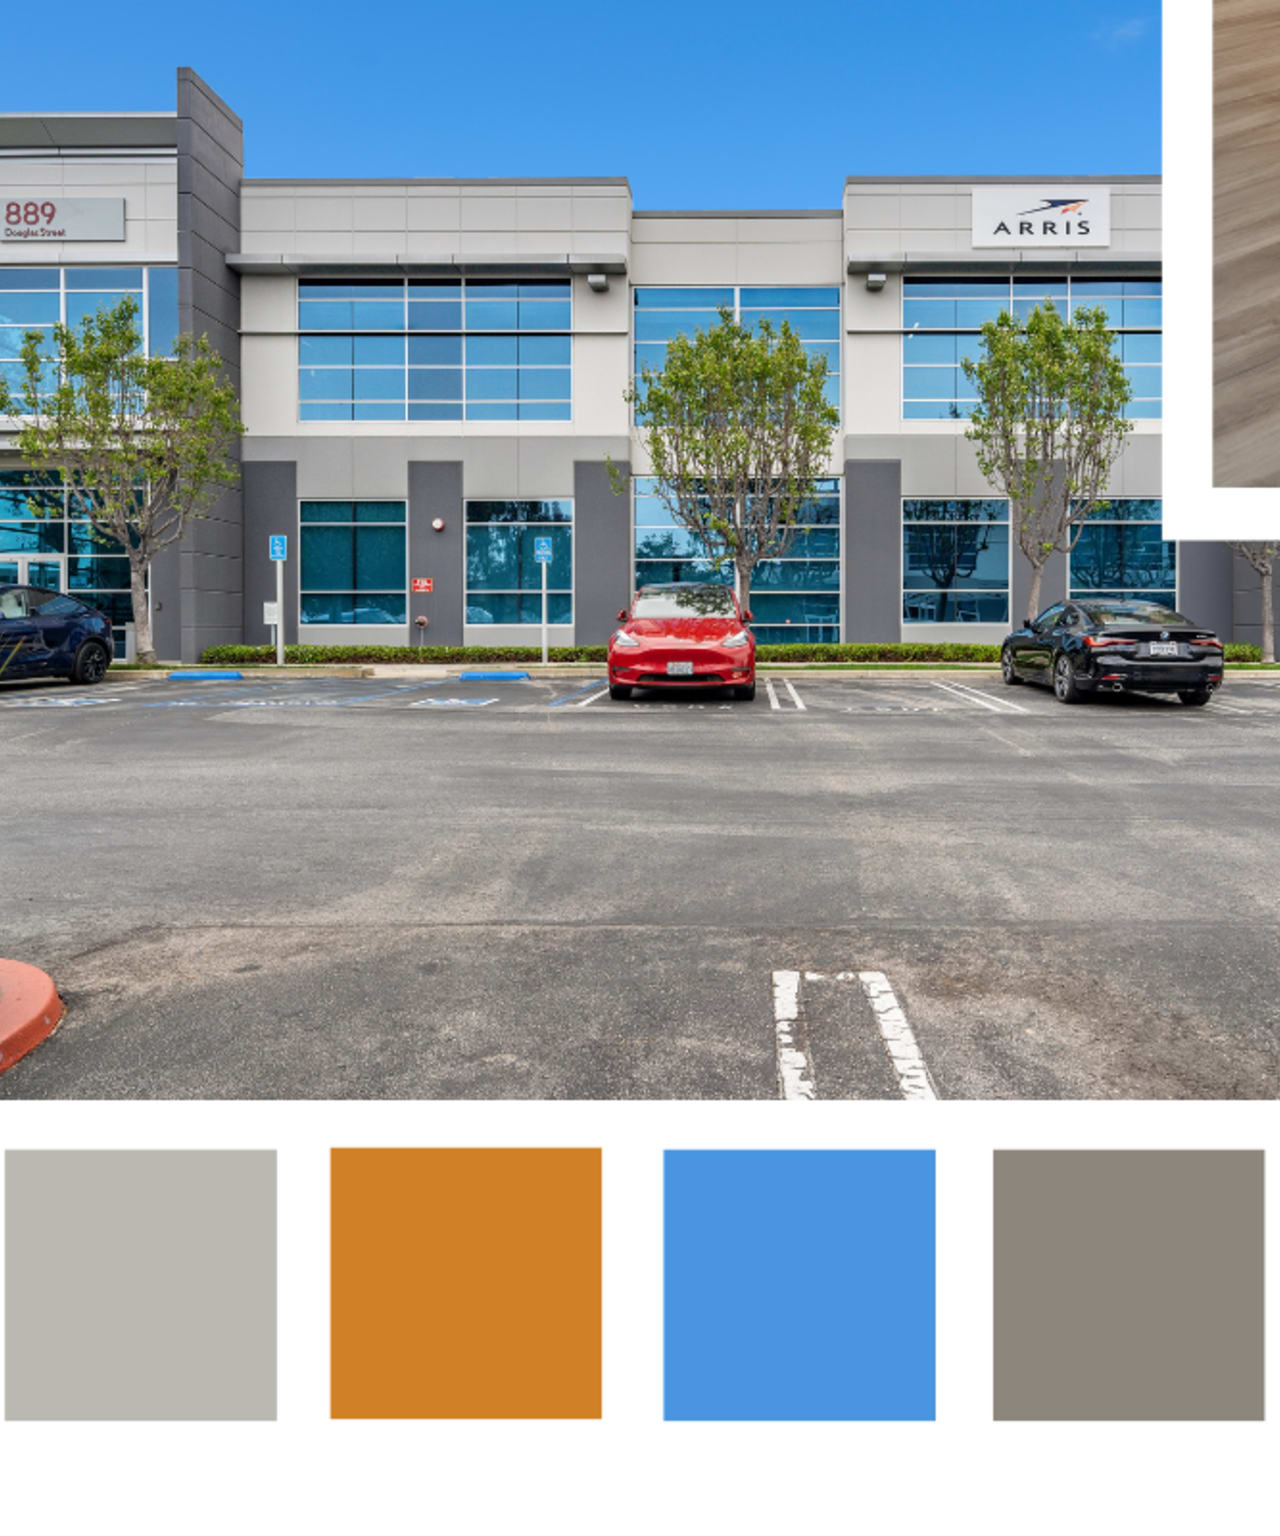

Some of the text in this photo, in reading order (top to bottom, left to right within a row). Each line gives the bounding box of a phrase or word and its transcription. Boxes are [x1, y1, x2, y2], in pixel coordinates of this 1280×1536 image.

[5, 201, 56, 225] 889
[4, 227, 66, 238] Douglas Street
[993, 220, 1090, 235] ARRIS
